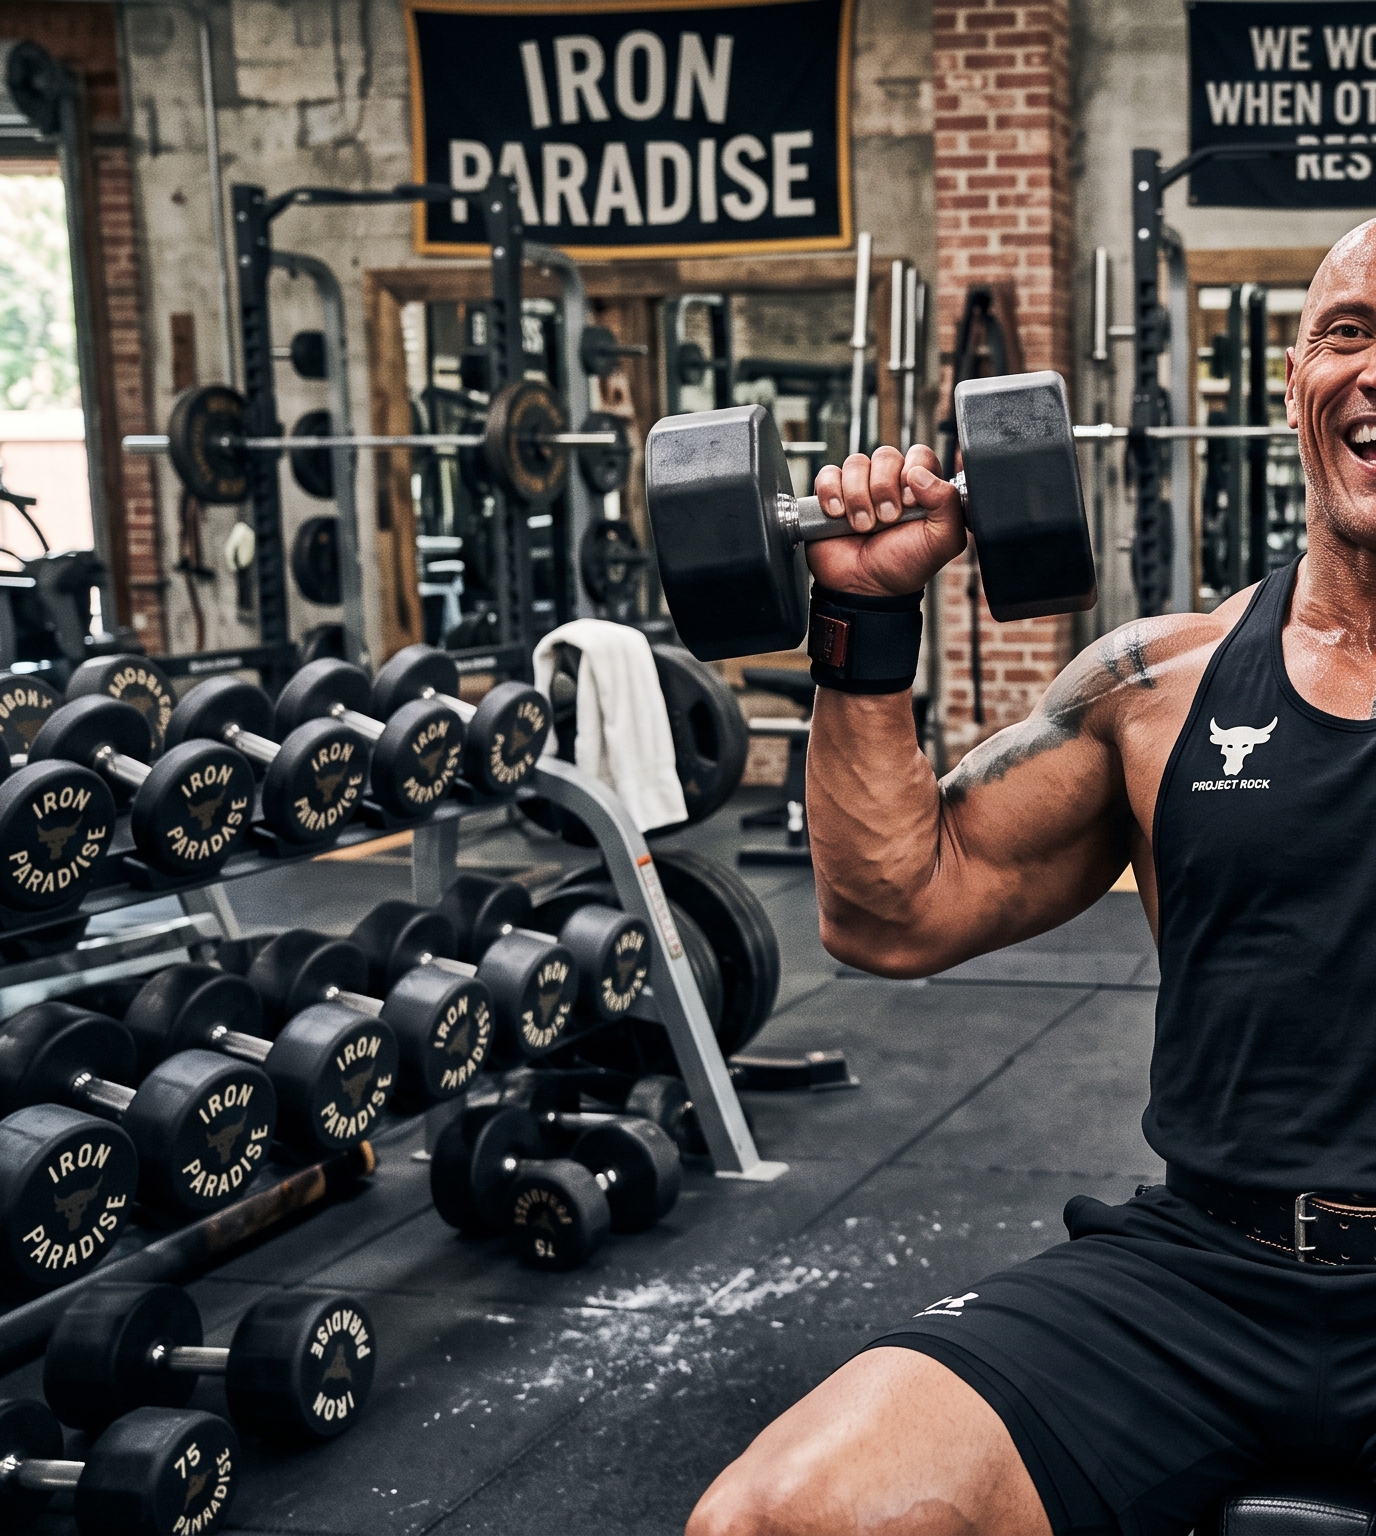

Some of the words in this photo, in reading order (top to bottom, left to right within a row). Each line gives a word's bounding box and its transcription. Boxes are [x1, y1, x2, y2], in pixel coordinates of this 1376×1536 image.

[1249, 27, 1311, 70] WE
[519, 30, 735, 129] IRON
[1206, 82, 1321, 125] WHEN
[449, 130, 816, 226] PARADISE
[311, 742, 355, 772] IRON
[181, 764, 233, 798] IRON
[1191, 780, 1238, 792] PROJECT
[1239, 779, 1270, 789] ROCK
[32, 786, 91, 819] IRON
[434, 995, 468, 1048] IRON
[336, 1036, 382, 1072] IRON
[199, 1083, 254, 1125] IRON
[321, 1073, 392, 1139] PARADISE
[48, 1143, 112, 1184] IRON
[182, 1124, 268, 1198] PARADISE
[22, 1193, 126, 1270] PARADISE
[310, 1309, 371, 1360] PARADISE
[312, 1390, 355, 1421] IRON
[174, 1442, 201, 1479] 75
